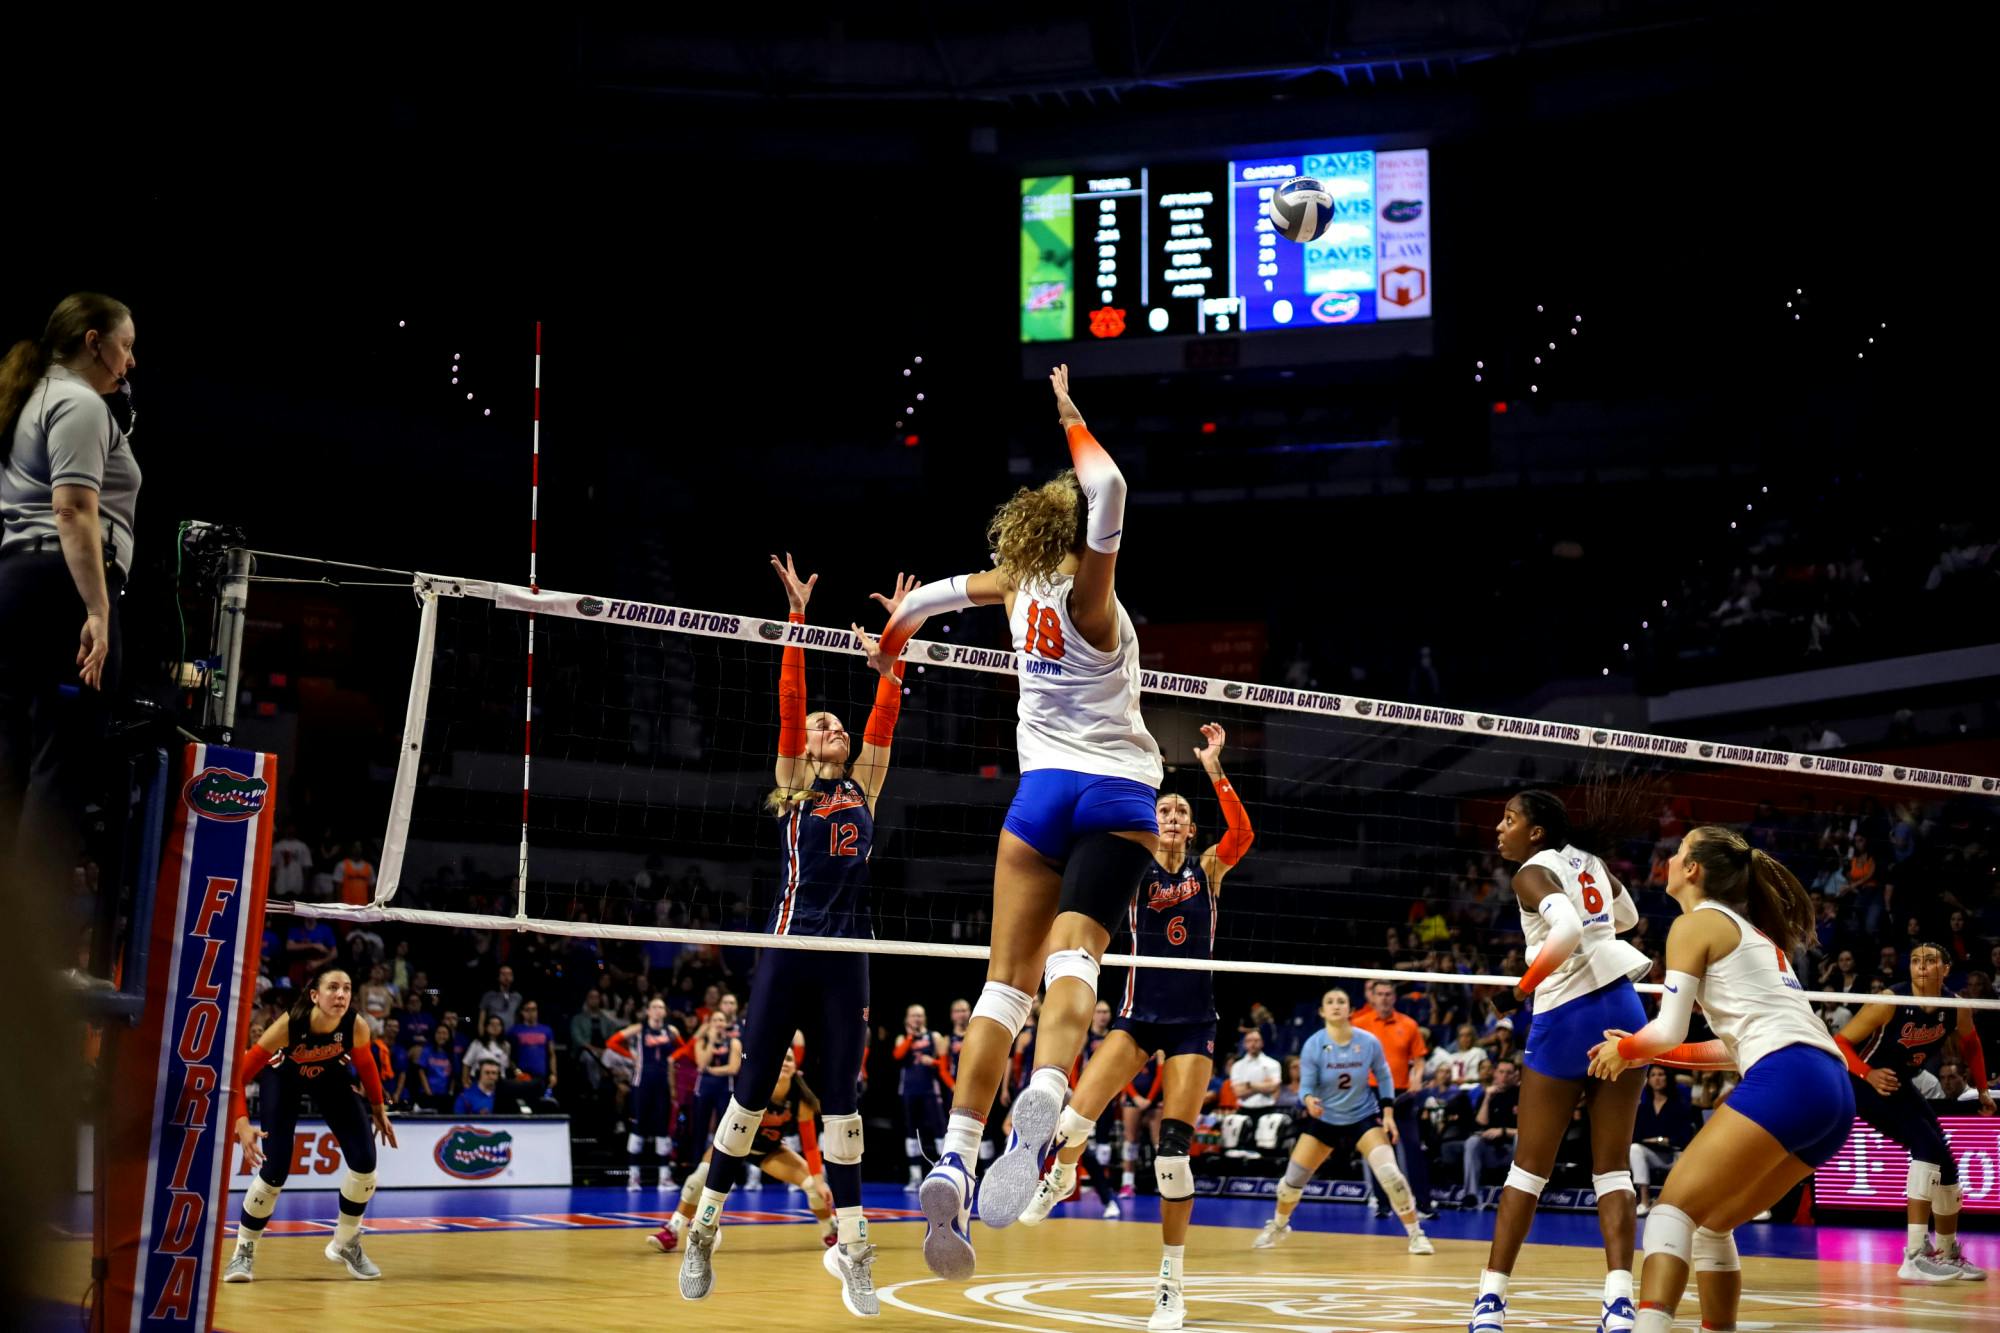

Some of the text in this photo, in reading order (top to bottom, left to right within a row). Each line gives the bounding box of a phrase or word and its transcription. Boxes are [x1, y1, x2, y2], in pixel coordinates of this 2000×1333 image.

[1307, 152, 1370, 172] DAVIS
[1308, 246, 1371, 262] DAVIS
[1380, 241, 1424, 259] LAW
[1149, 307, 1169, 332] 0
[1273, 300, 1293, 323] 0
[607, 602, 742, 635] FLORIDA GATORS
[1024, 599, 1066, 661] 18
[787, 626, 850, 649] FLORIDA
[953, 648, 1016, 668] FLORIDA
[1160, 675, 1208, 695] GATORS
[1245, 686, 1342, 712] FLORIDA GATORS
[1376, 703, 1465, 727] FLORIDA GATORS
[1497, 718, 1580, 741] FLORIDA GATORS
[1610, 733, 1688, 754] FLORIDA GATORS
[1716, 746, 1789, 766] FLORIDA GATORS
[1815, 757, 1884, 777] FLORIDA GATORS
[1908, 769, 1973, 788] FLORIDA GATORS
[830, 822, 858, 857] 12
[1577, 870, 1604, 915] 6
[1166, 915, 1187, 945] 6
[299, 1065, 326, 1079] 10
[1338, 1073, 1352, 1090] 2
[149, 876, 238, 1320] FLORIDA
